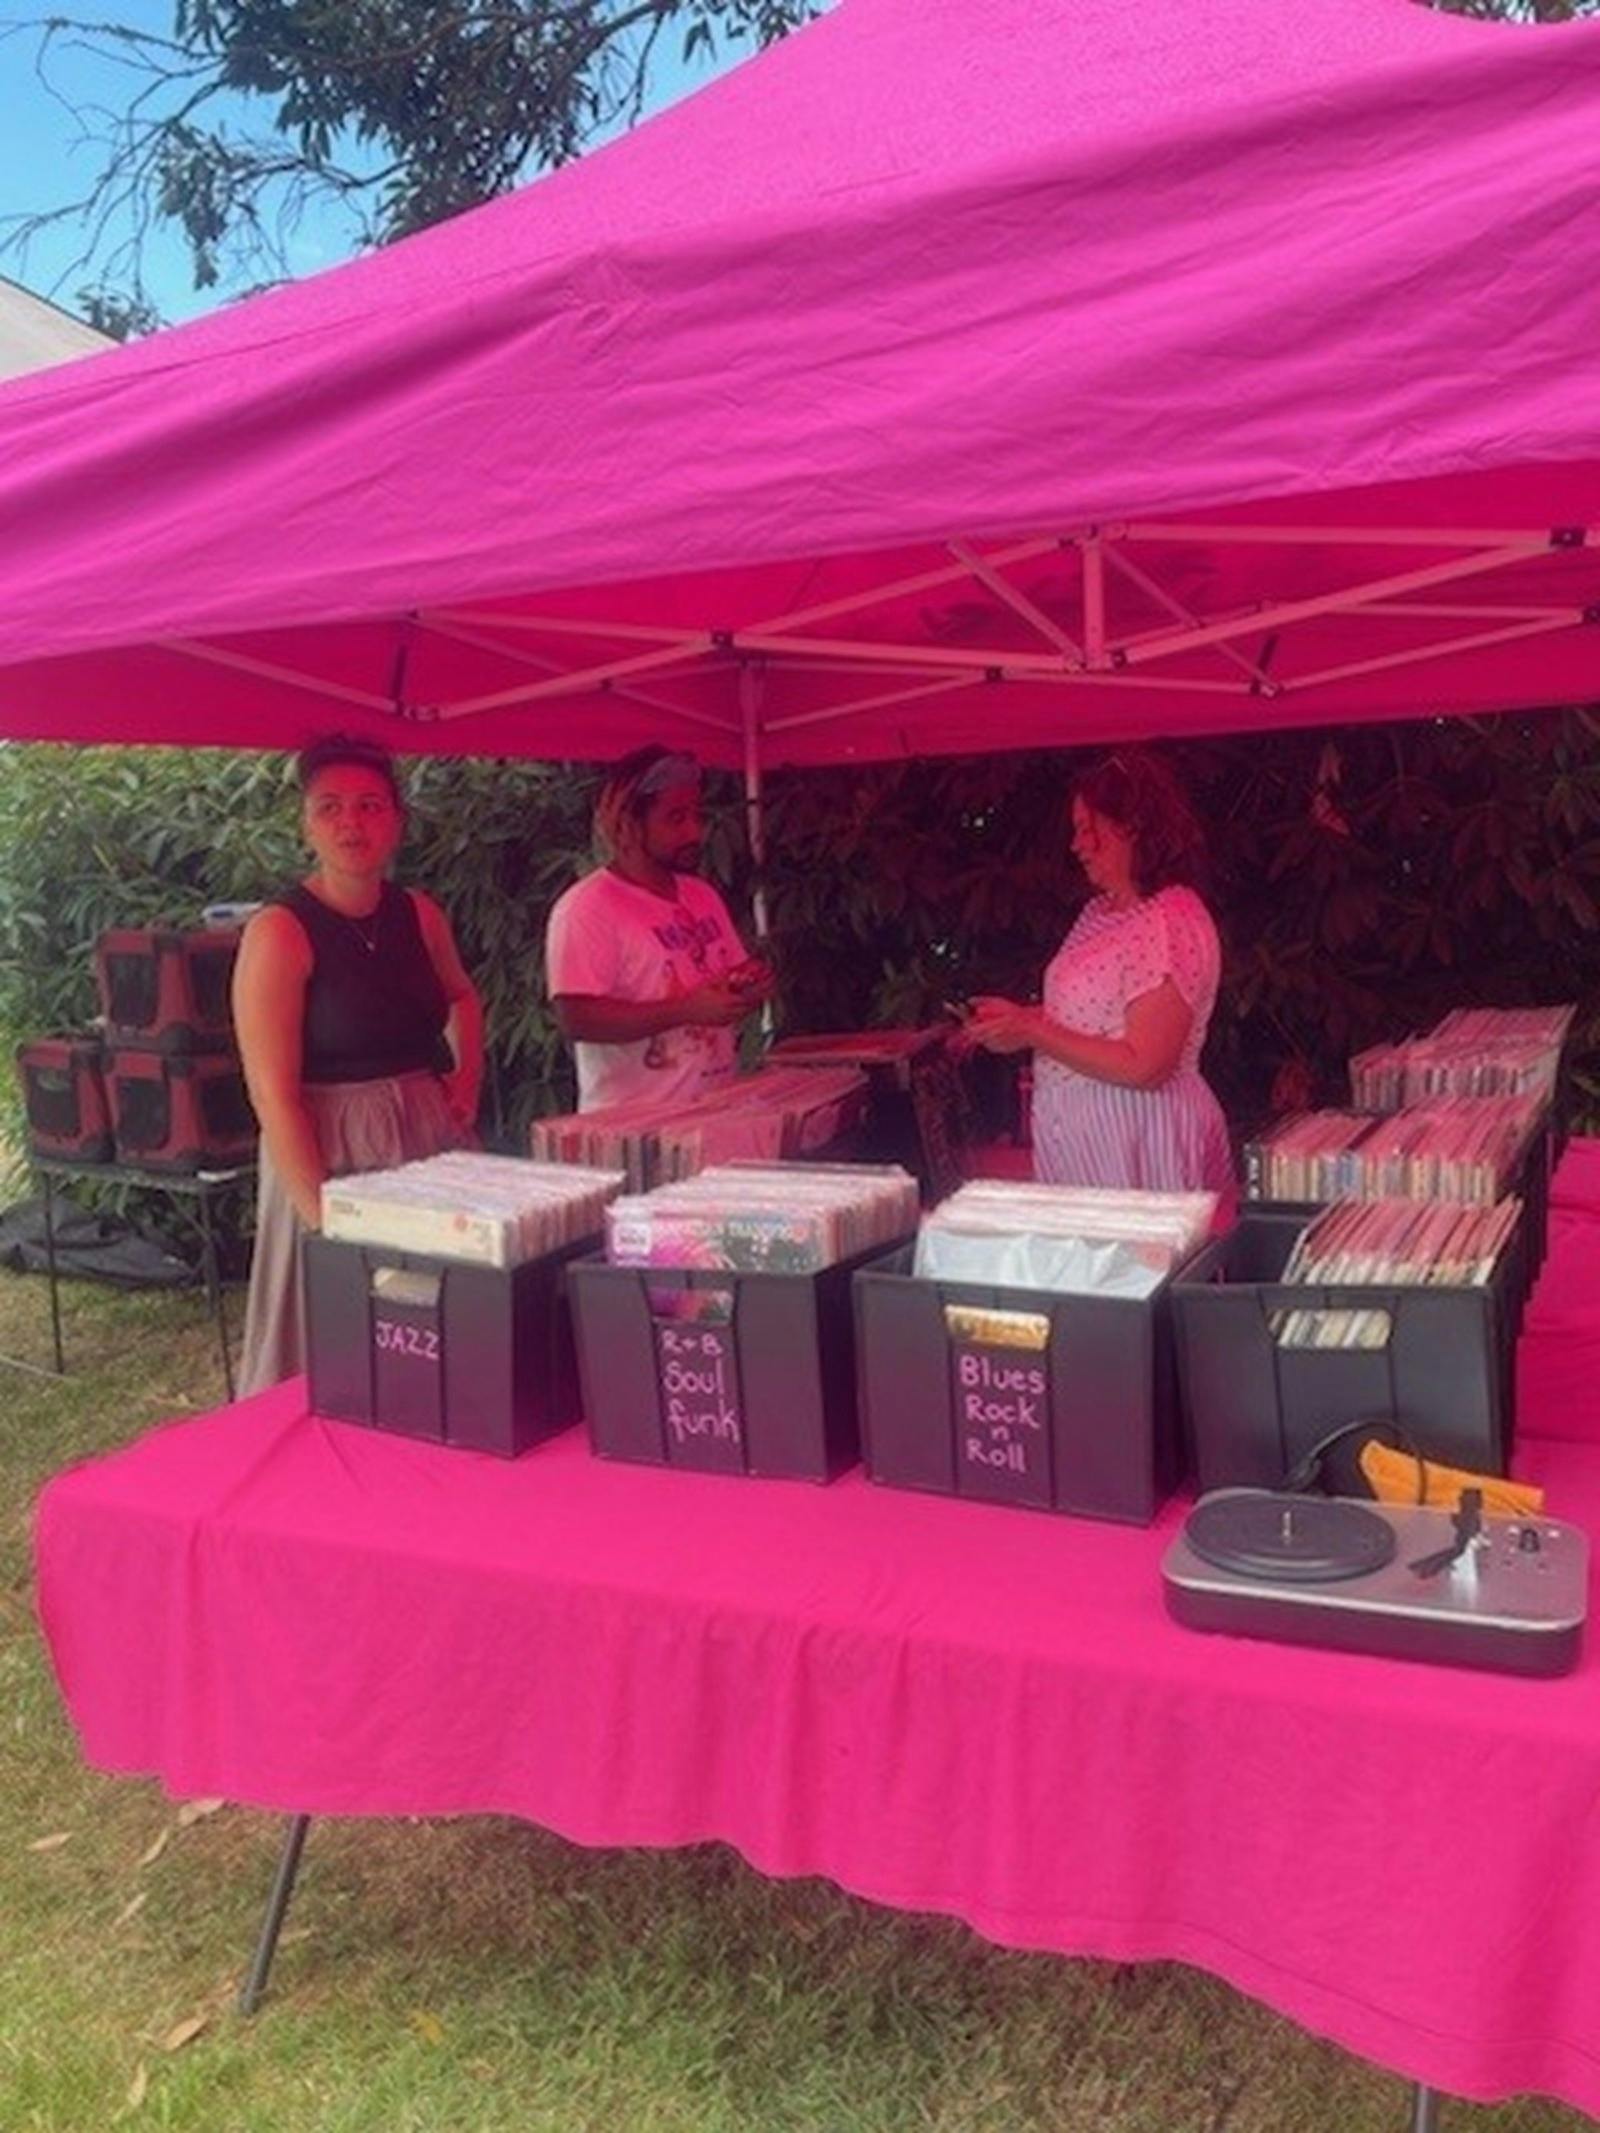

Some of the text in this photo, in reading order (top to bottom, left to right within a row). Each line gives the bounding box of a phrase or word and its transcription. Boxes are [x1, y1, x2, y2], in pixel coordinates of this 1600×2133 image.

[375, 1320, 440, 1360] JAZZ
[663, 1358, 724, 1394] Soul
[959, 1354, 1046, 1395] Blues
[668, 1398, 740, 1443] funk
[965, 1393, 1041, 1430] Rock
[991, 1424, 1010, 1442] n
[966, 1437, 1026, 1474] Roll
